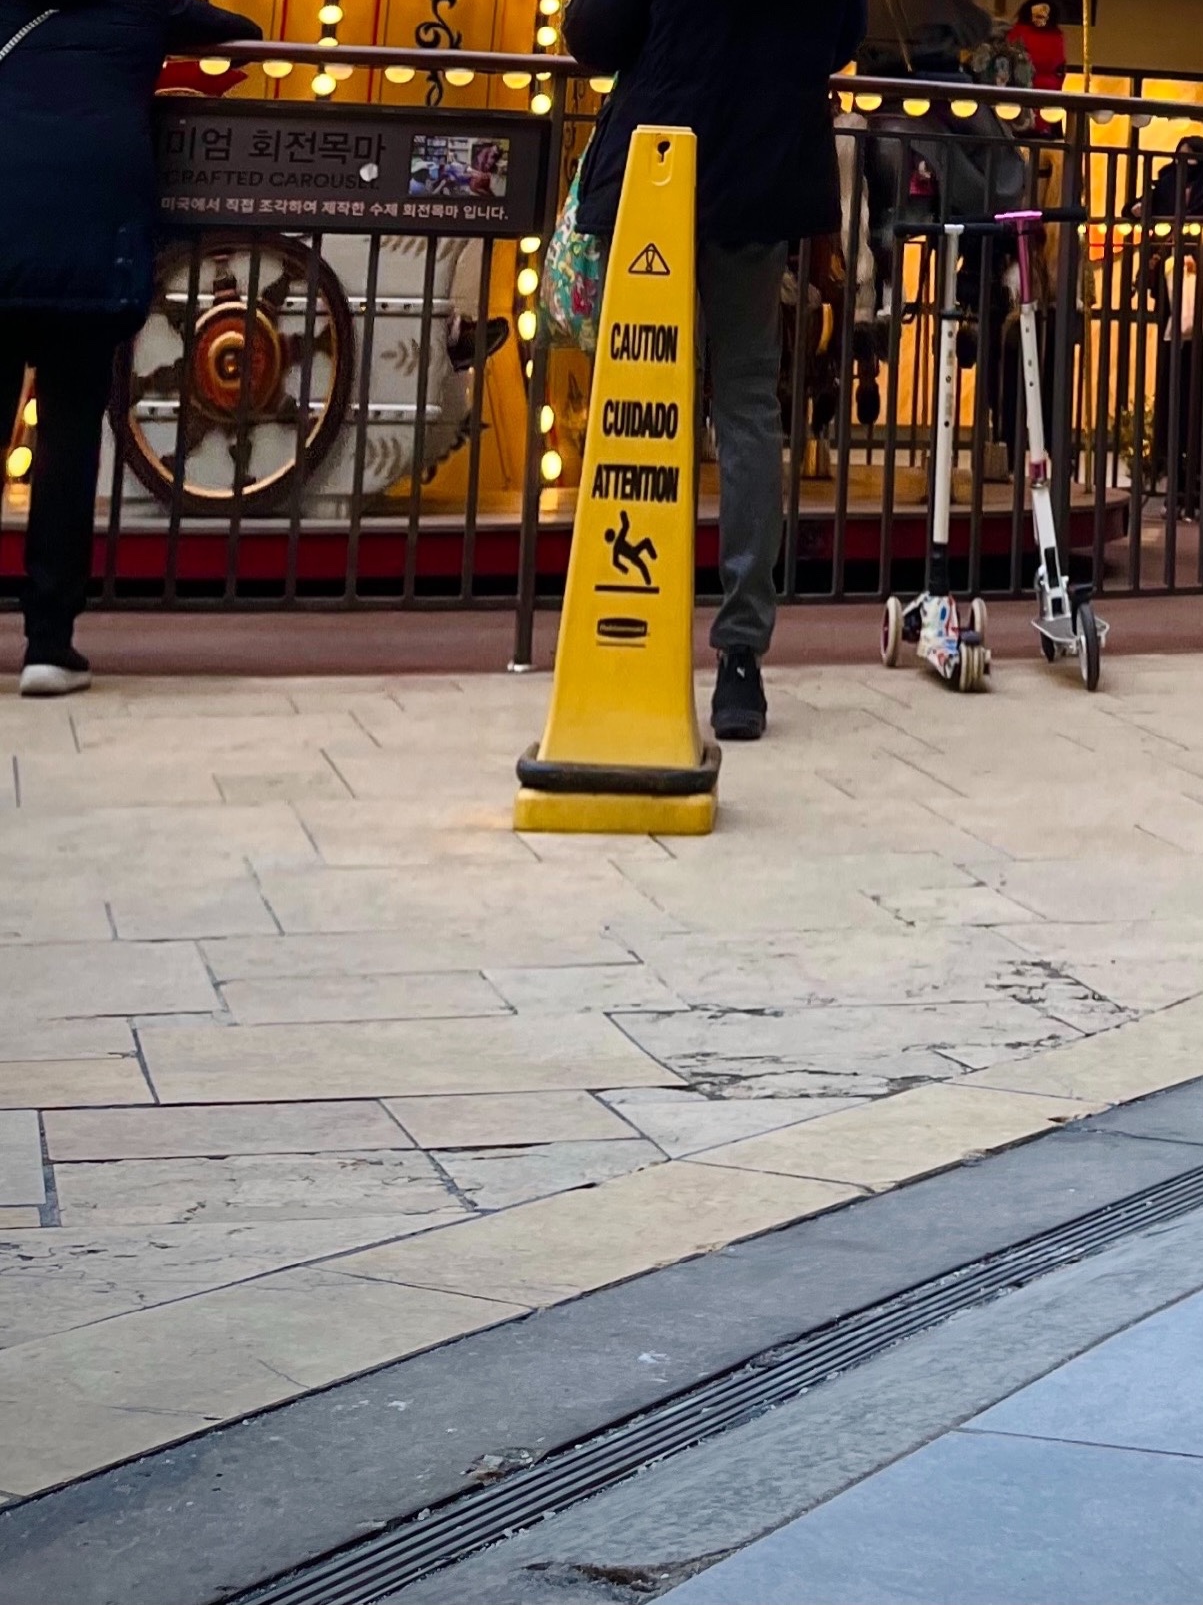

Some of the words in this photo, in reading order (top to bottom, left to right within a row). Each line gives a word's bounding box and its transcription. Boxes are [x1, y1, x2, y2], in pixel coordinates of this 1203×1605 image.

[154, 125, 233, 162] 미엄
[248, 128, 386, 168] 회전목마
[160, 197, 222, 213] 미국에서
[225, 197, 255, 214] 직접
[258, 199, 318, 216] 조각하여
[321, 200, 366, 217] 제작한
[369, 202, 399, 217] 수제
[402, 203, 459, 220] 회전목마
[463, 205, 509, 221] 입니다.
[610, 322, 679, 364] CAUTION
[602, 398, 679, 440] CUIDADO
[591, 462, 680, 503] ATTENTION
